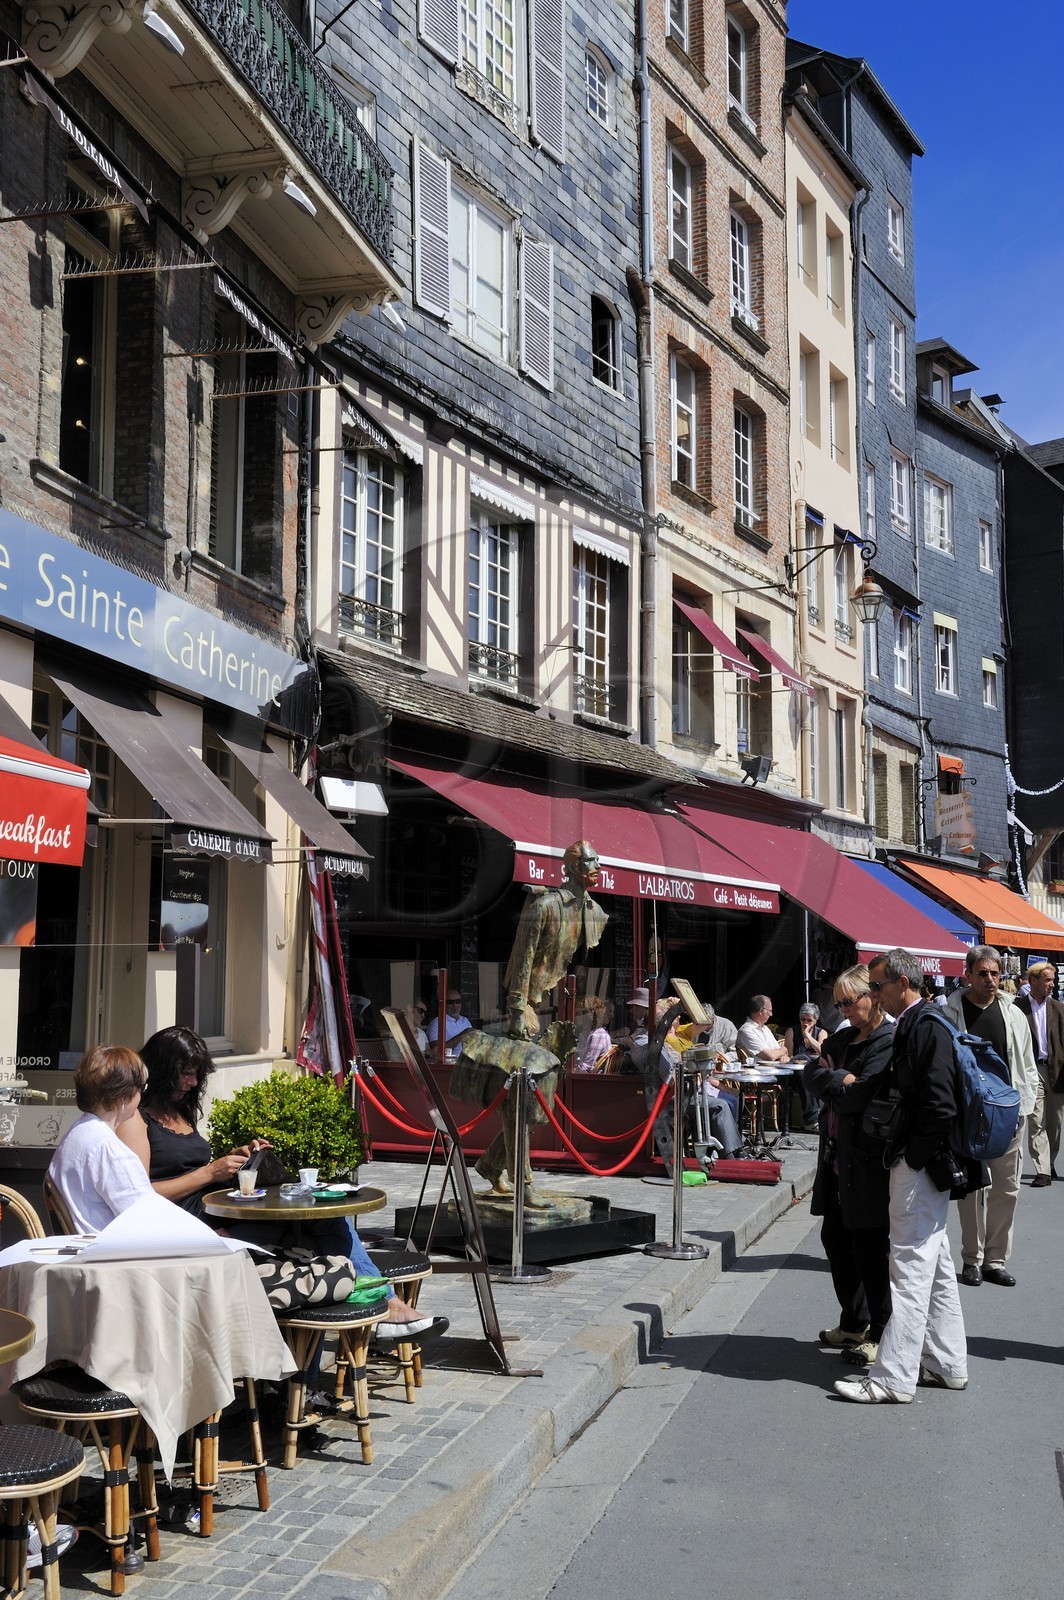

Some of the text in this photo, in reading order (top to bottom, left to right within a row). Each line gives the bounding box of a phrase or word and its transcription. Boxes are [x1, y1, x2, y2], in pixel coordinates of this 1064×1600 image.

[57, 105, 122, 188] TABLEAUX
[36, 553, 143, 648] Sainte
[164, 615, 282, 708] Catherine
[187, 829, 231, 854] GALERIE
[235, 838, 261, 857] d'ART
[324, 855, 364, 875] SCULPTURES
[528, 859, 545, 880] Bar
[600, 870, 615, 890] Thé
[638, 874, 695, 901] L'ALBATROS
[713, 887, 728, 905] Café
[734, 890, 748, 906] Petit
